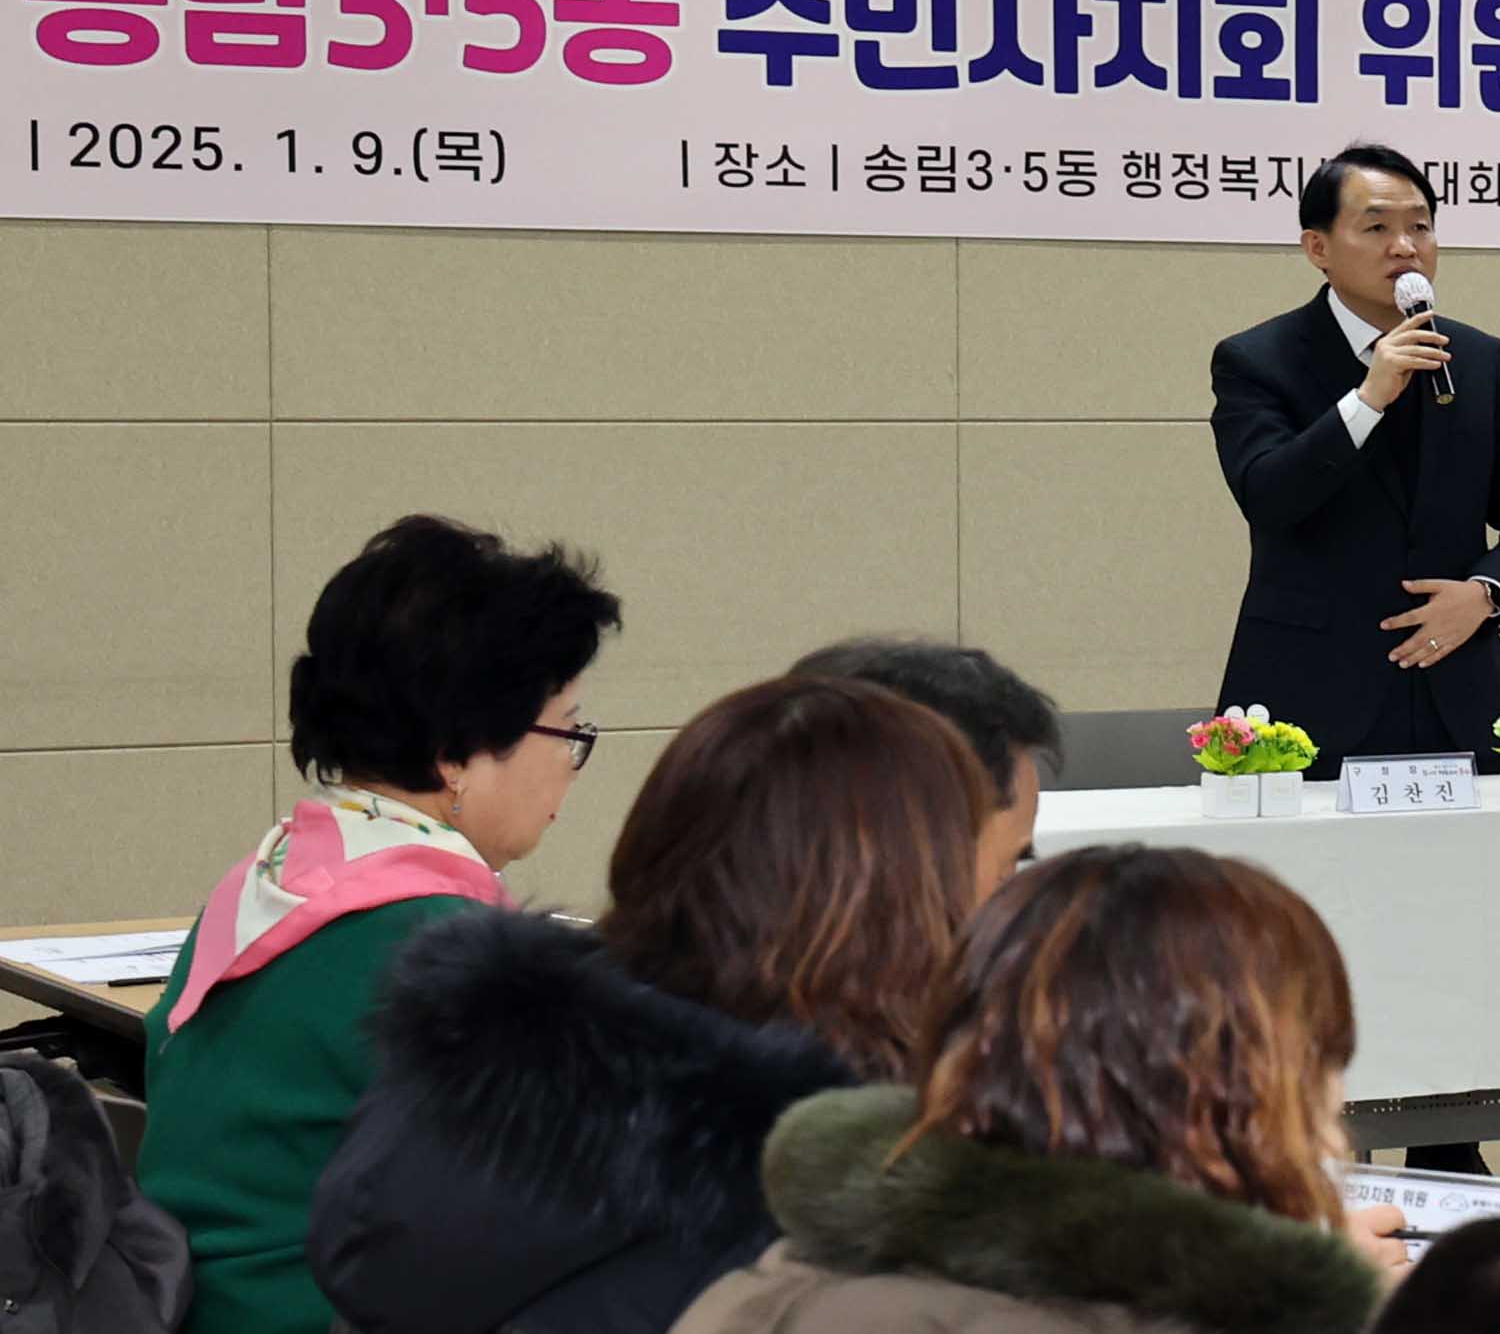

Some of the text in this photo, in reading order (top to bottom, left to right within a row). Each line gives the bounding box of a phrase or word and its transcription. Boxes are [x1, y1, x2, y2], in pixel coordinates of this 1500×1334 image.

[68, 121, 243, 173] 2025.
[276, 128, 324, 175] 1.
[714, 142, 807, 189] 장소
[863, 143, 1098, 199] 송림3·5동
